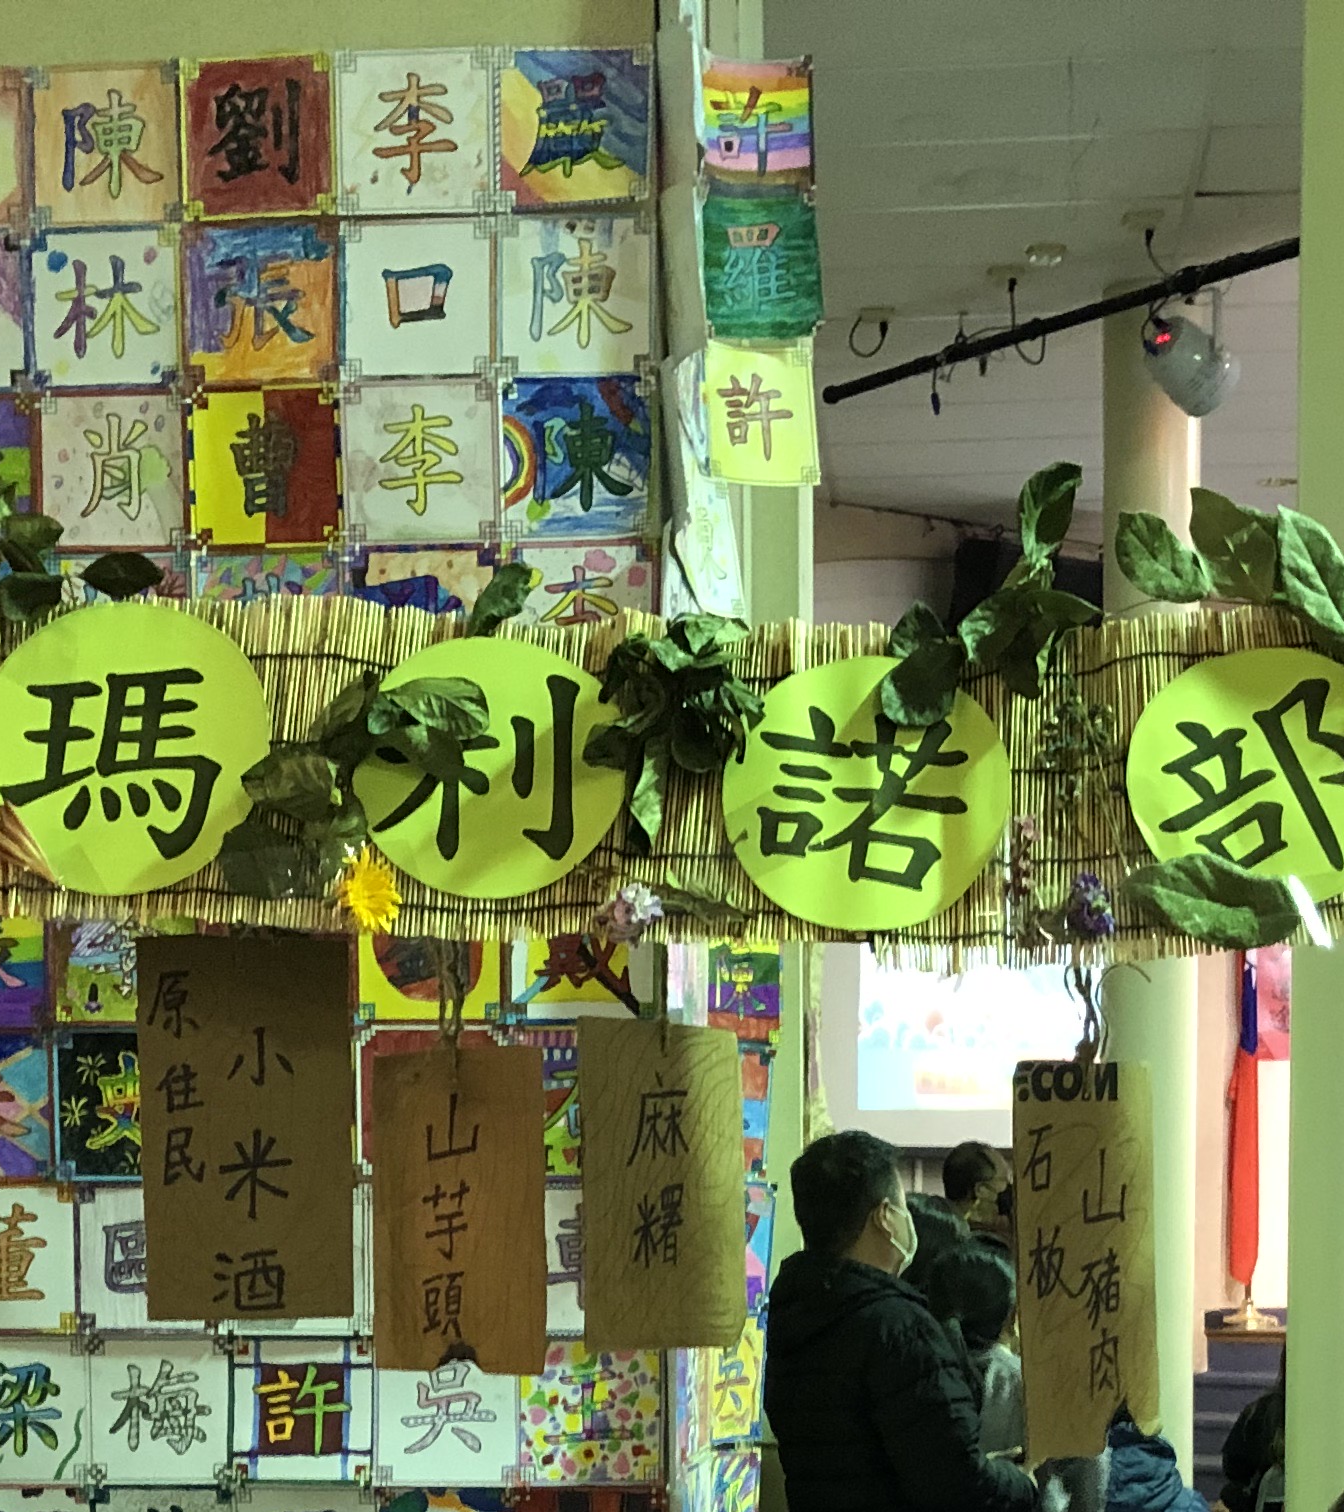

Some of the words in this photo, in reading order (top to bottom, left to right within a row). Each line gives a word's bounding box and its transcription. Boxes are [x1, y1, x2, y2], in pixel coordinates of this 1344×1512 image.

[61, 88, 164, 199] 陳
[207, 78, 302, 185] 劉
[372, 72, 458, 184] 李
[55, 255, 160, 359] 林
[382, 263, 453, 329] 口
[530, 238, 633, 349] 陳
[722, 223, 796, 302] 羅
[81, 413, 148, 521] 肖
[379, 404, 463, 516] 李
[534, 402, 634, 511] 陳
[717, 373, 793, 461] 許
[146, 970, 207, 1186] 原住民
[212, 1026, 294, 1312] 小米酒
[421, 1093, 480, 1338] 山芋頭
[627, 1071, 690, 1268] 麻糬
[1022, 1123, 1072, 1300] 石板
[109, 1359, 211, 1455] 梅
[255, 1363, 351, 1456] 許
